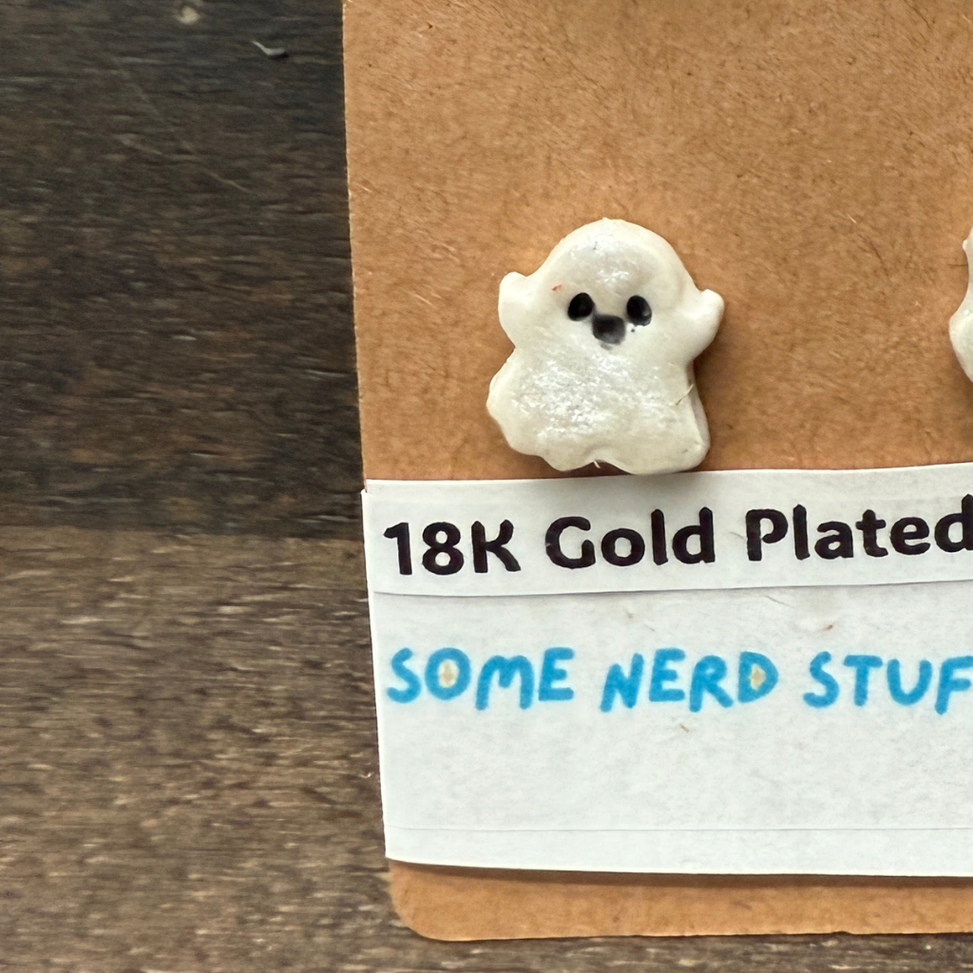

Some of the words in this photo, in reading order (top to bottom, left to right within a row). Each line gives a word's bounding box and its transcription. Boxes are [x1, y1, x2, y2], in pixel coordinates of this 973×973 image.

[384, 519, 522, 576] 18K
[544, 506, 717, 570] Gold
[386, 647, 576, 712] SOME
[599, 647, 780, 714] NERD
